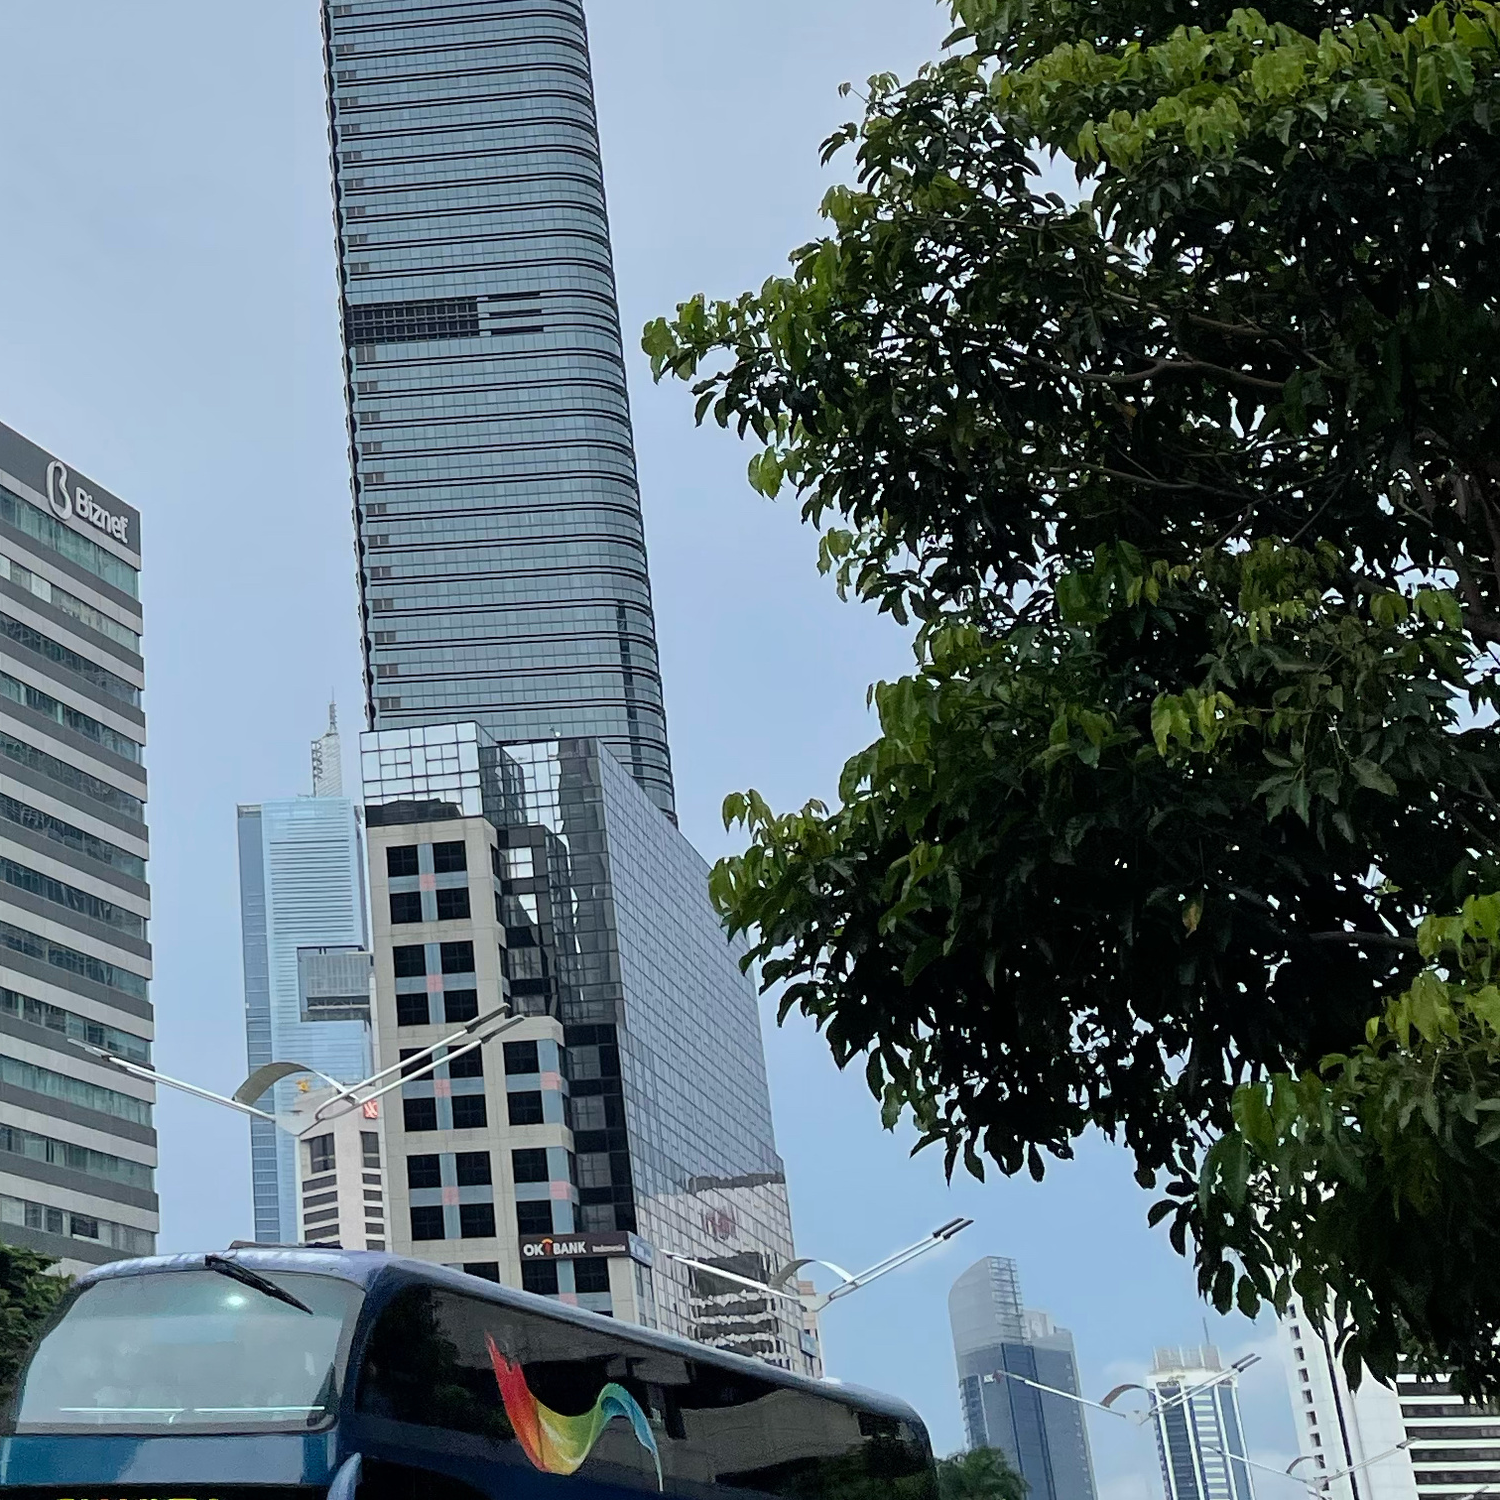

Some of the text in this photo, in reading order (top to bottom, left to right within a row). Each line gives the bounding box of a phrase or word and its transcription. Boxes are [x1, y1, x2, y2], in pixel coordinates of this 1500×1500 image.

[75, 486, 129, 545] Biznet
[523, 1243, 545, 1257] OK
[552, 1241, 587, 1256] BANK
